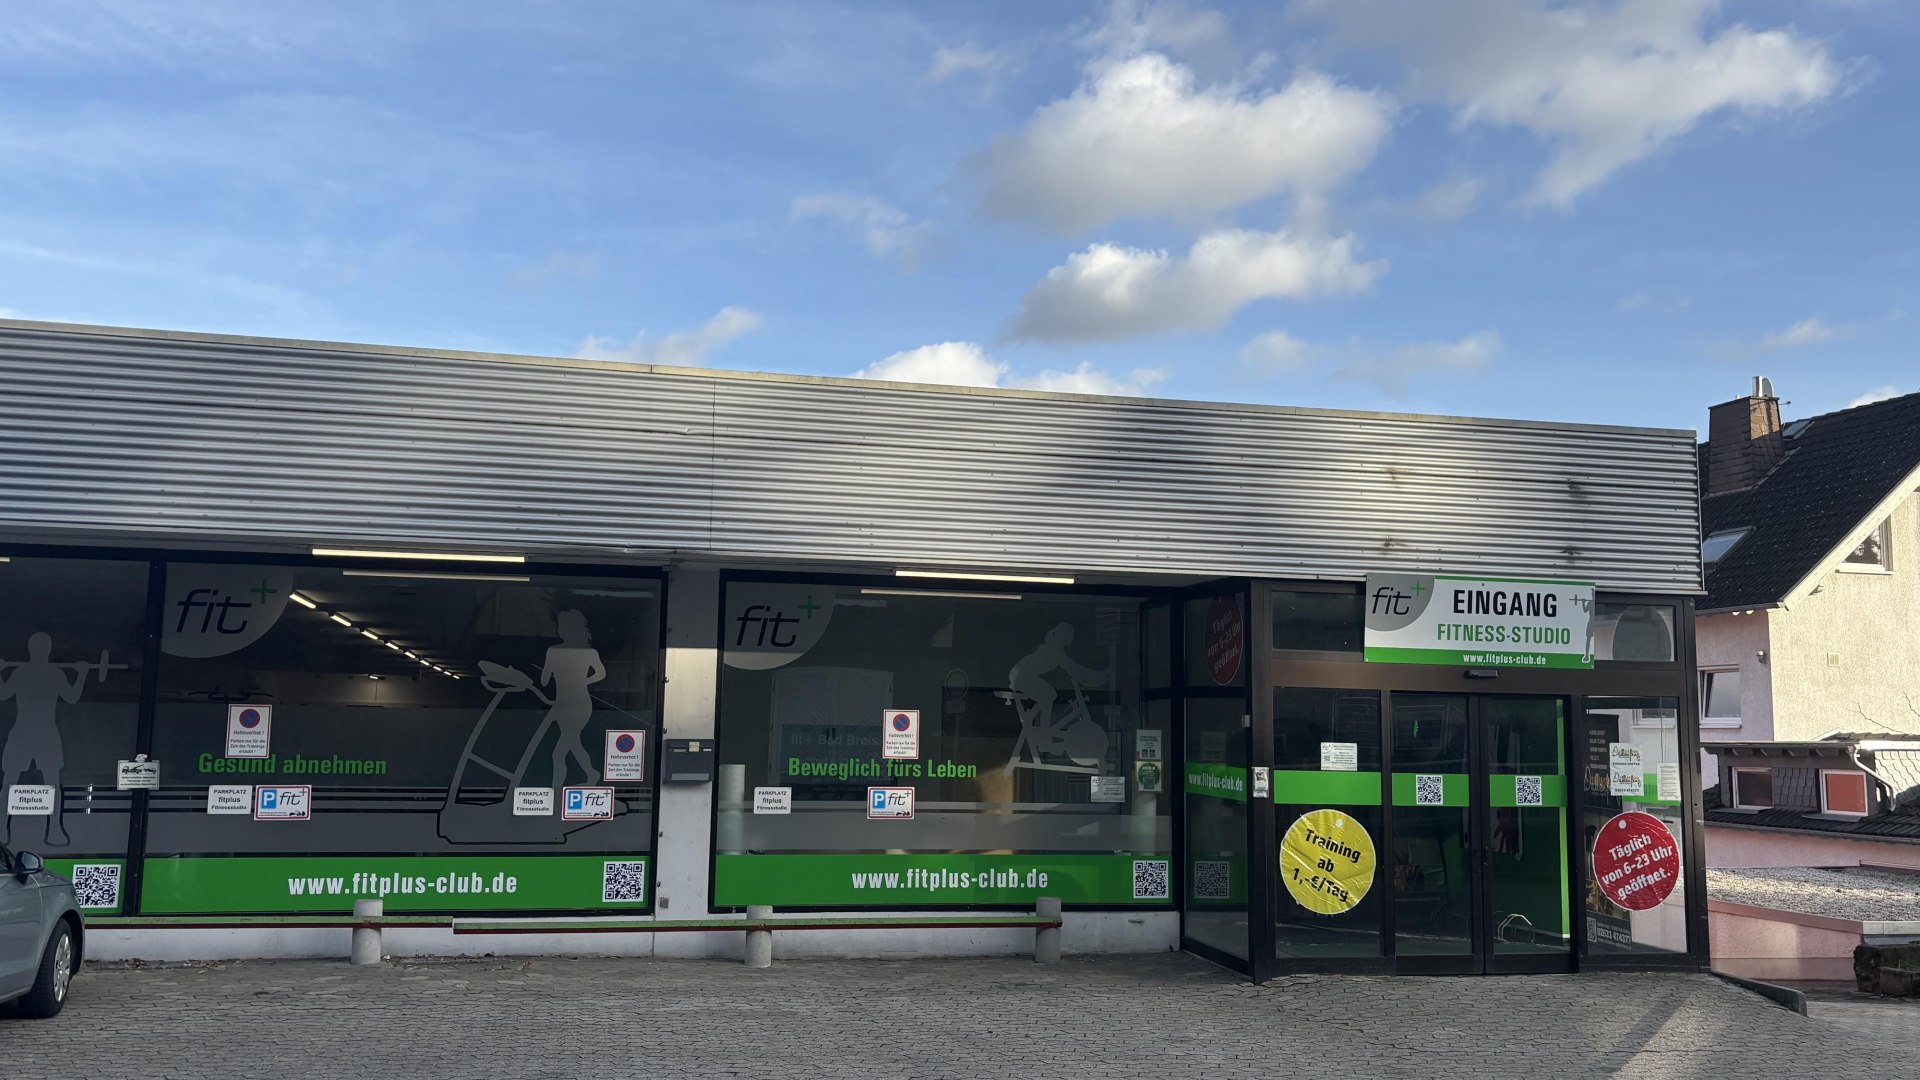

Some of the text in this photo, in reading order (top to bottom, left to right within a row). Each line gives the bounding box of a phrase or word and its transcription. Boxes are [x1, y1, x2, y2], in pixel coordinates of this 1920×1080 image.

[1453, 589, 1557, 617] EINGANG
[1437, 624, 1571, 645] FITNESS-STUDIO
[1463, 653, 1546, 665] www.fitplus-club.de
[198, 753, 387, 775] Gesund abnehmen
[788, 757, 977, 780] Beweglich fürs Leben
[1189, 773, 1243, 791] www.fitplus-club.de
[1305, 829, 1361, 863] Training
[1609, 834, 1652, 860] Täglich
[1317, 858, 1334, 872] ab
[1602, 846, 1672, 884] von 6-23 Uhr
[288, 872, 517, 897] www.fitplus-club.de
[852, 868, 1048, 891] www.fitplus-club.de
[1293, 868, 1348, 902] 1,-€/Tag
[1617, 867, 1671, 900] geöffnet.
